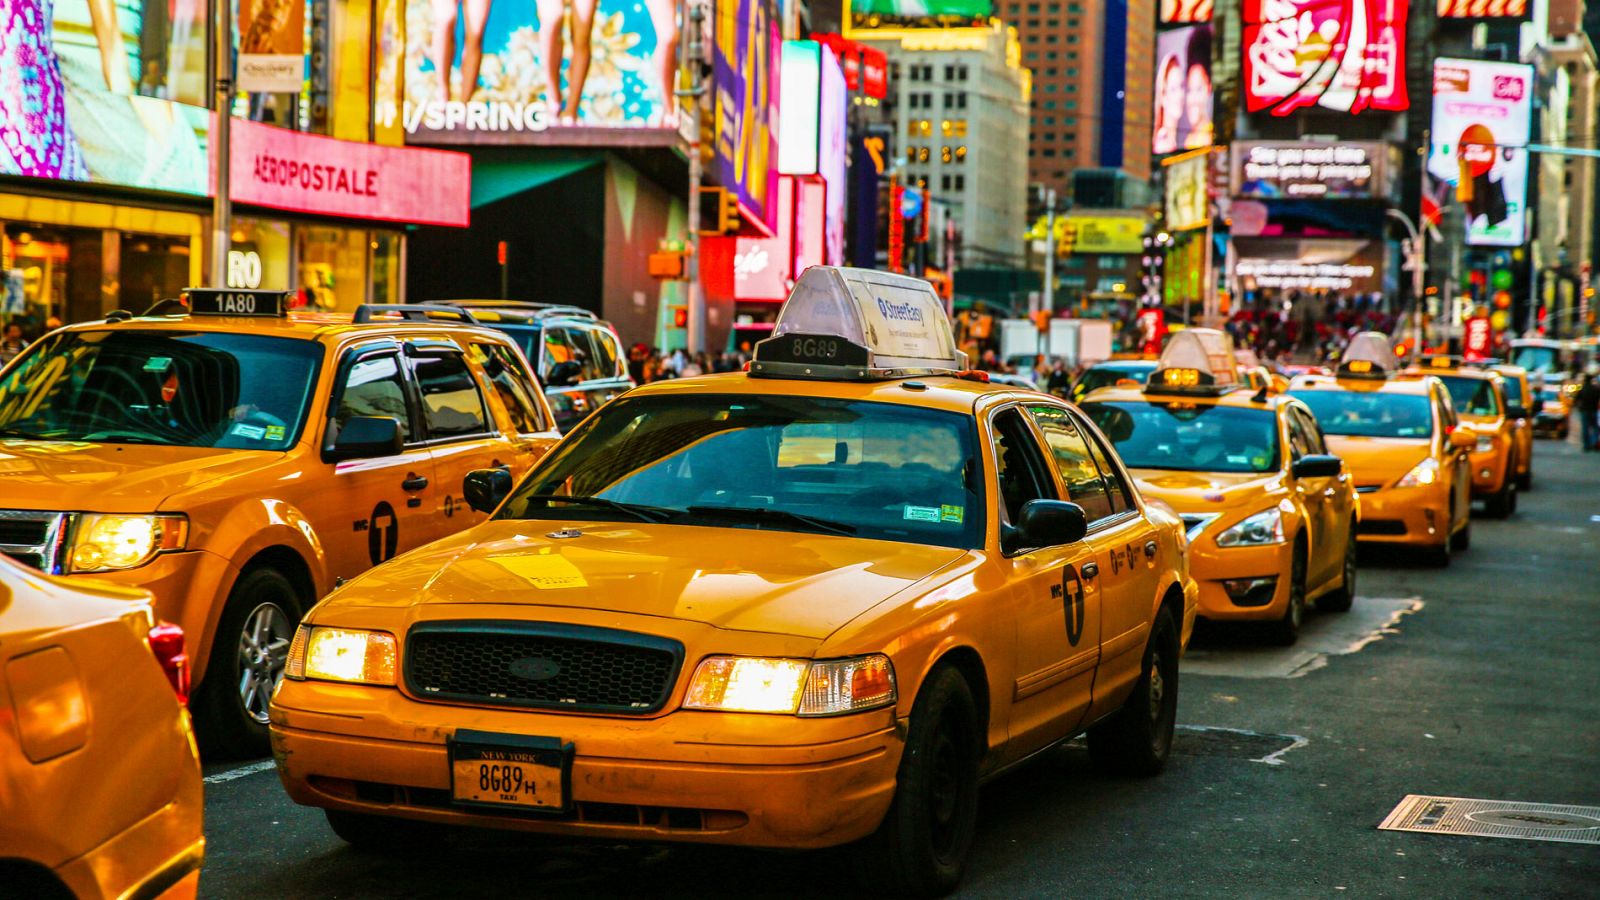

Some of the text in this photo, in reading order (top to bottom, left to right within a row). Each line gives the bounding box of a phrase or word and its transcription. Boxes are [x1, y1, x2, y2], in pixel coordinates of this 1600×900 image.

[216, 294, 255, 312] 1A80
[885, 300, 925, 327] StreetEasy
[792, 338, 837, 358] 8G89
[481, 751, 536, 762] NEW YORK
